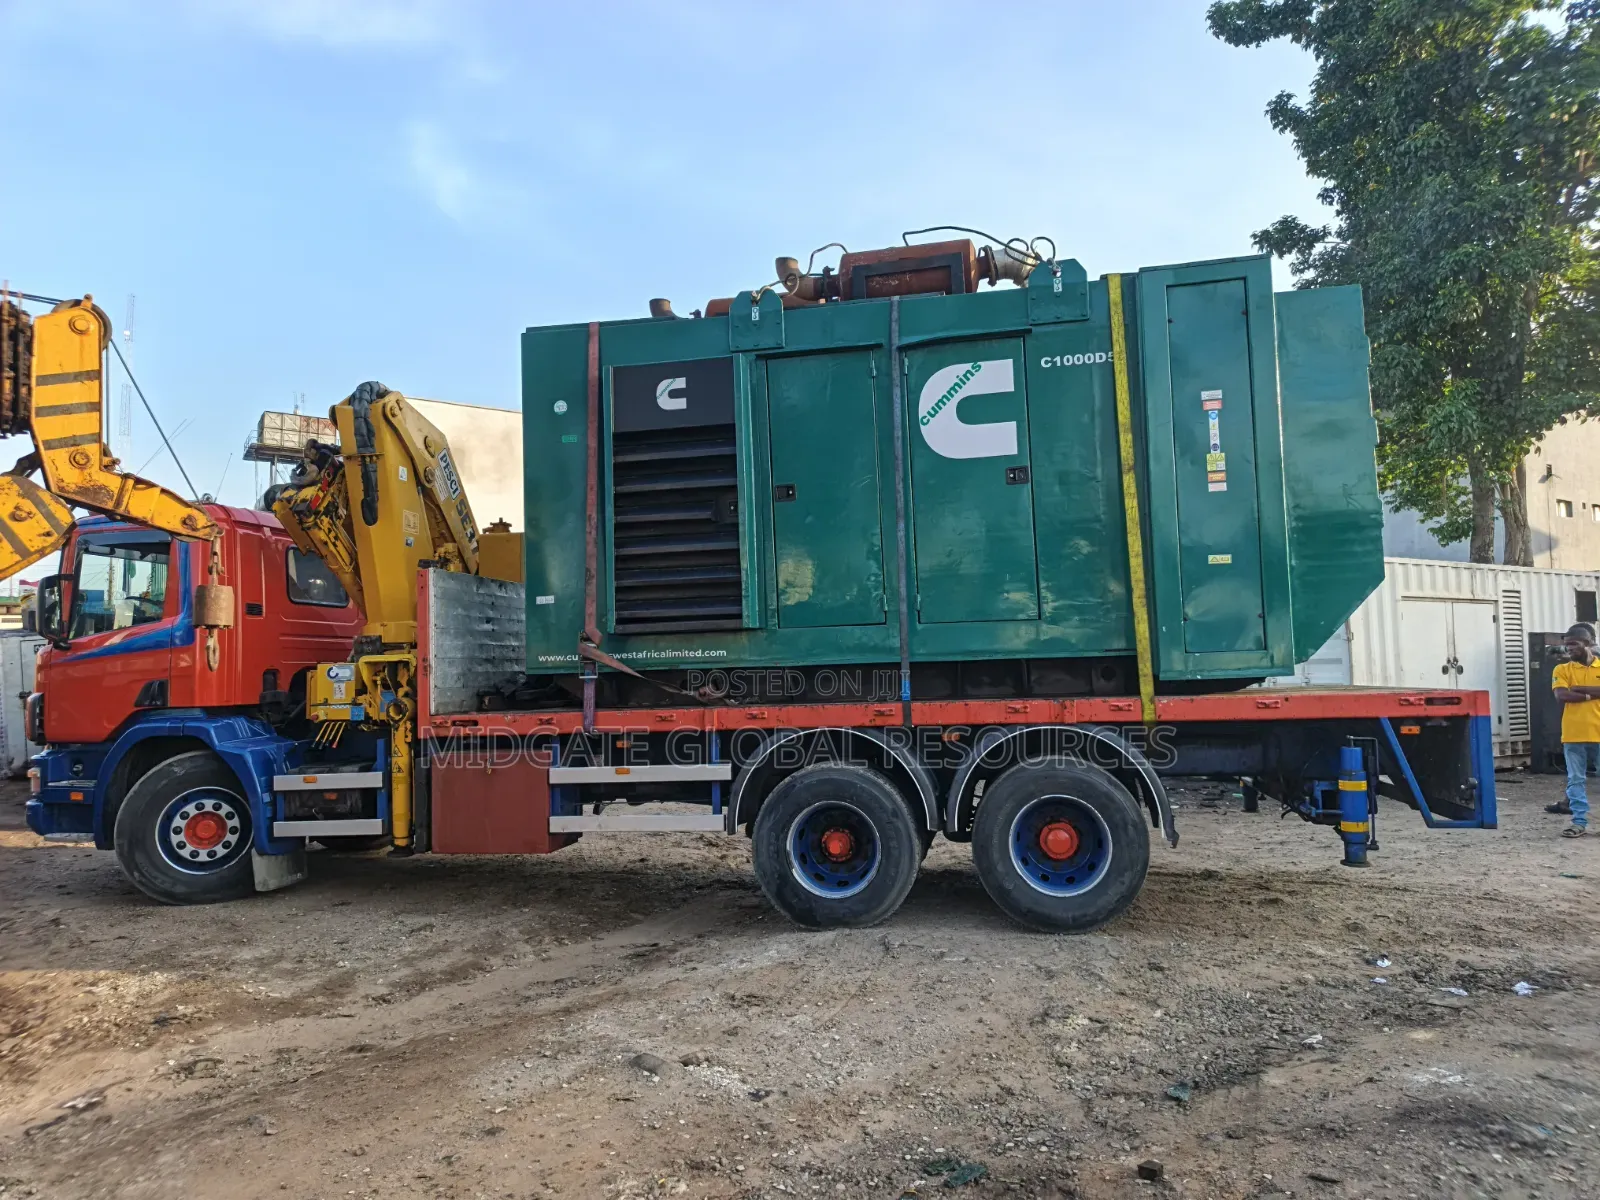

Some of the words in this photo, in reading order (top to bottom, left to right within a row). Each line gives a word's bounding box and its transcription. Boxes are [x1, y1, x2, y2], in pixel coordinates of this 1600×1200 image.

[1040, 352, 1115, 368] C1000D5
[919, 361, 983, 427] cummins
[439, 452, 460, 496] PESCI
